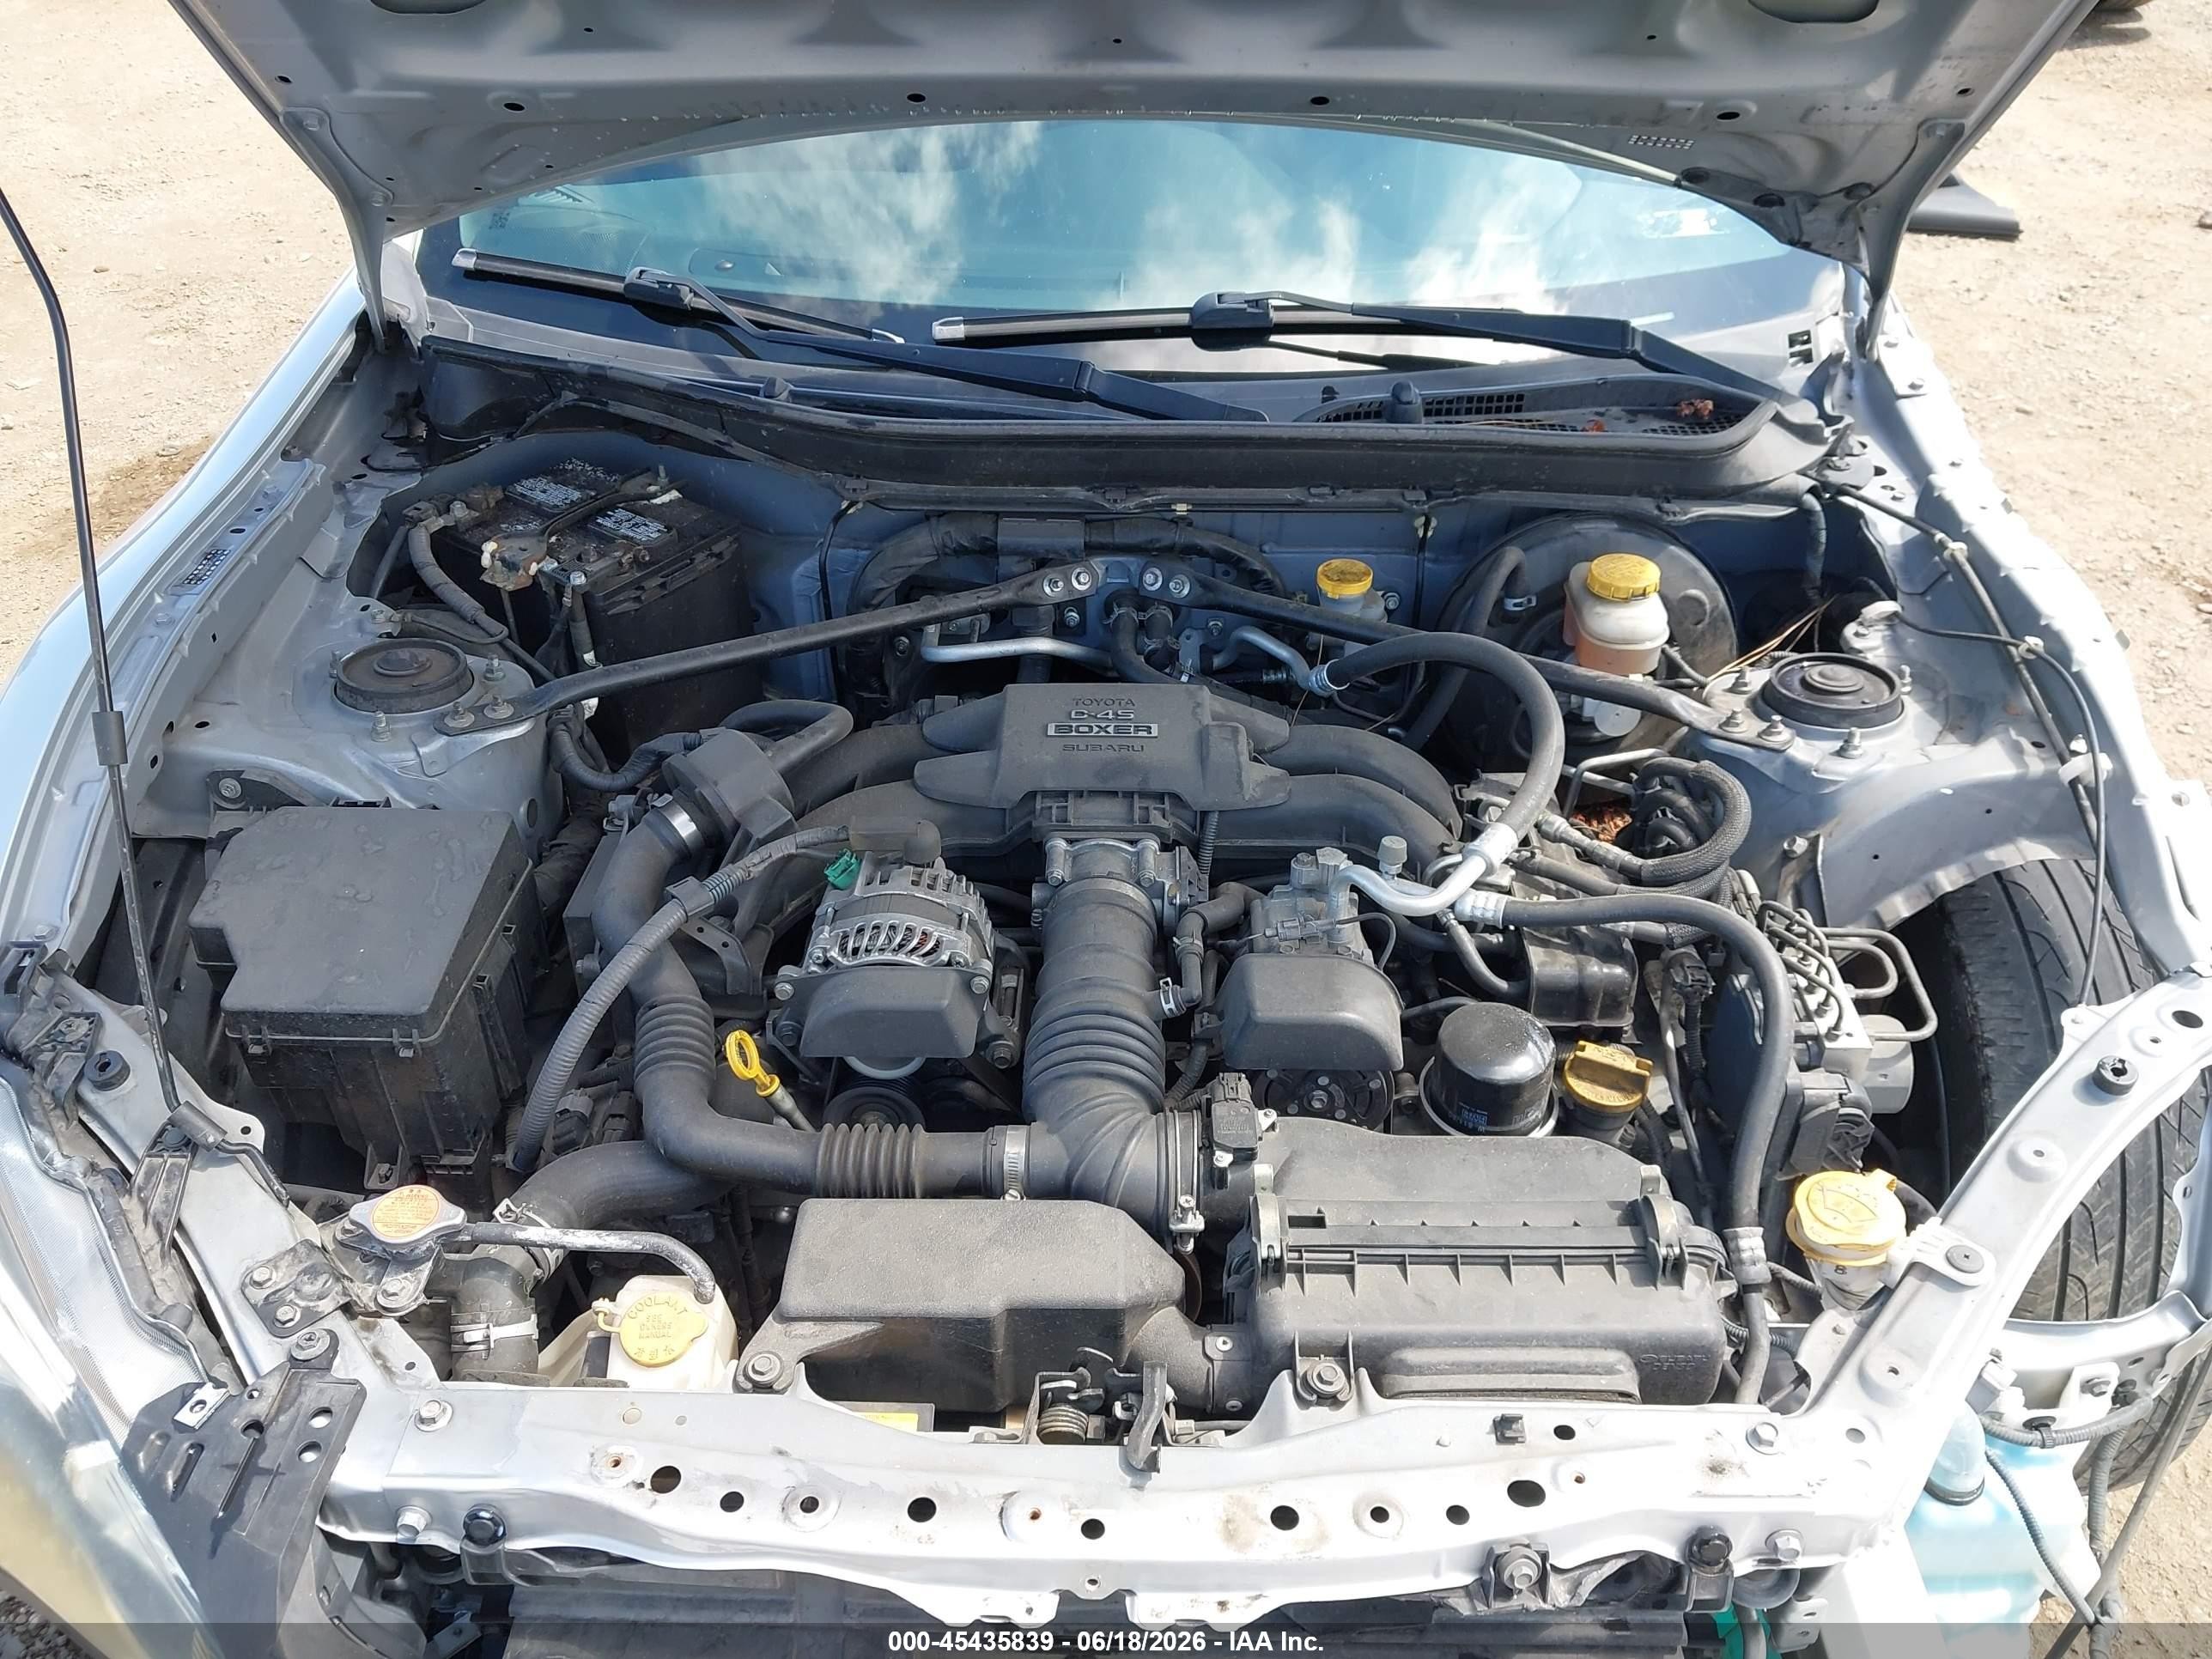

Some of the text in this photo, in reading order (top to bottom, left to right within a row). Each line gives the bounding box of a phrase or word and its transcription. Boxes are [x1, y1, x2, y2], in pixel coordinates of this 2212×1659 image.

[1073, 697, 1135, 707] TOYOTA
[1070, 709, 1135, 720] D-4S
[1054, 724, 1153, 735] BOXER
[1062, 744, 1145, 752] SUBARU
[627, 1295, 689, 1320] COOLANT
